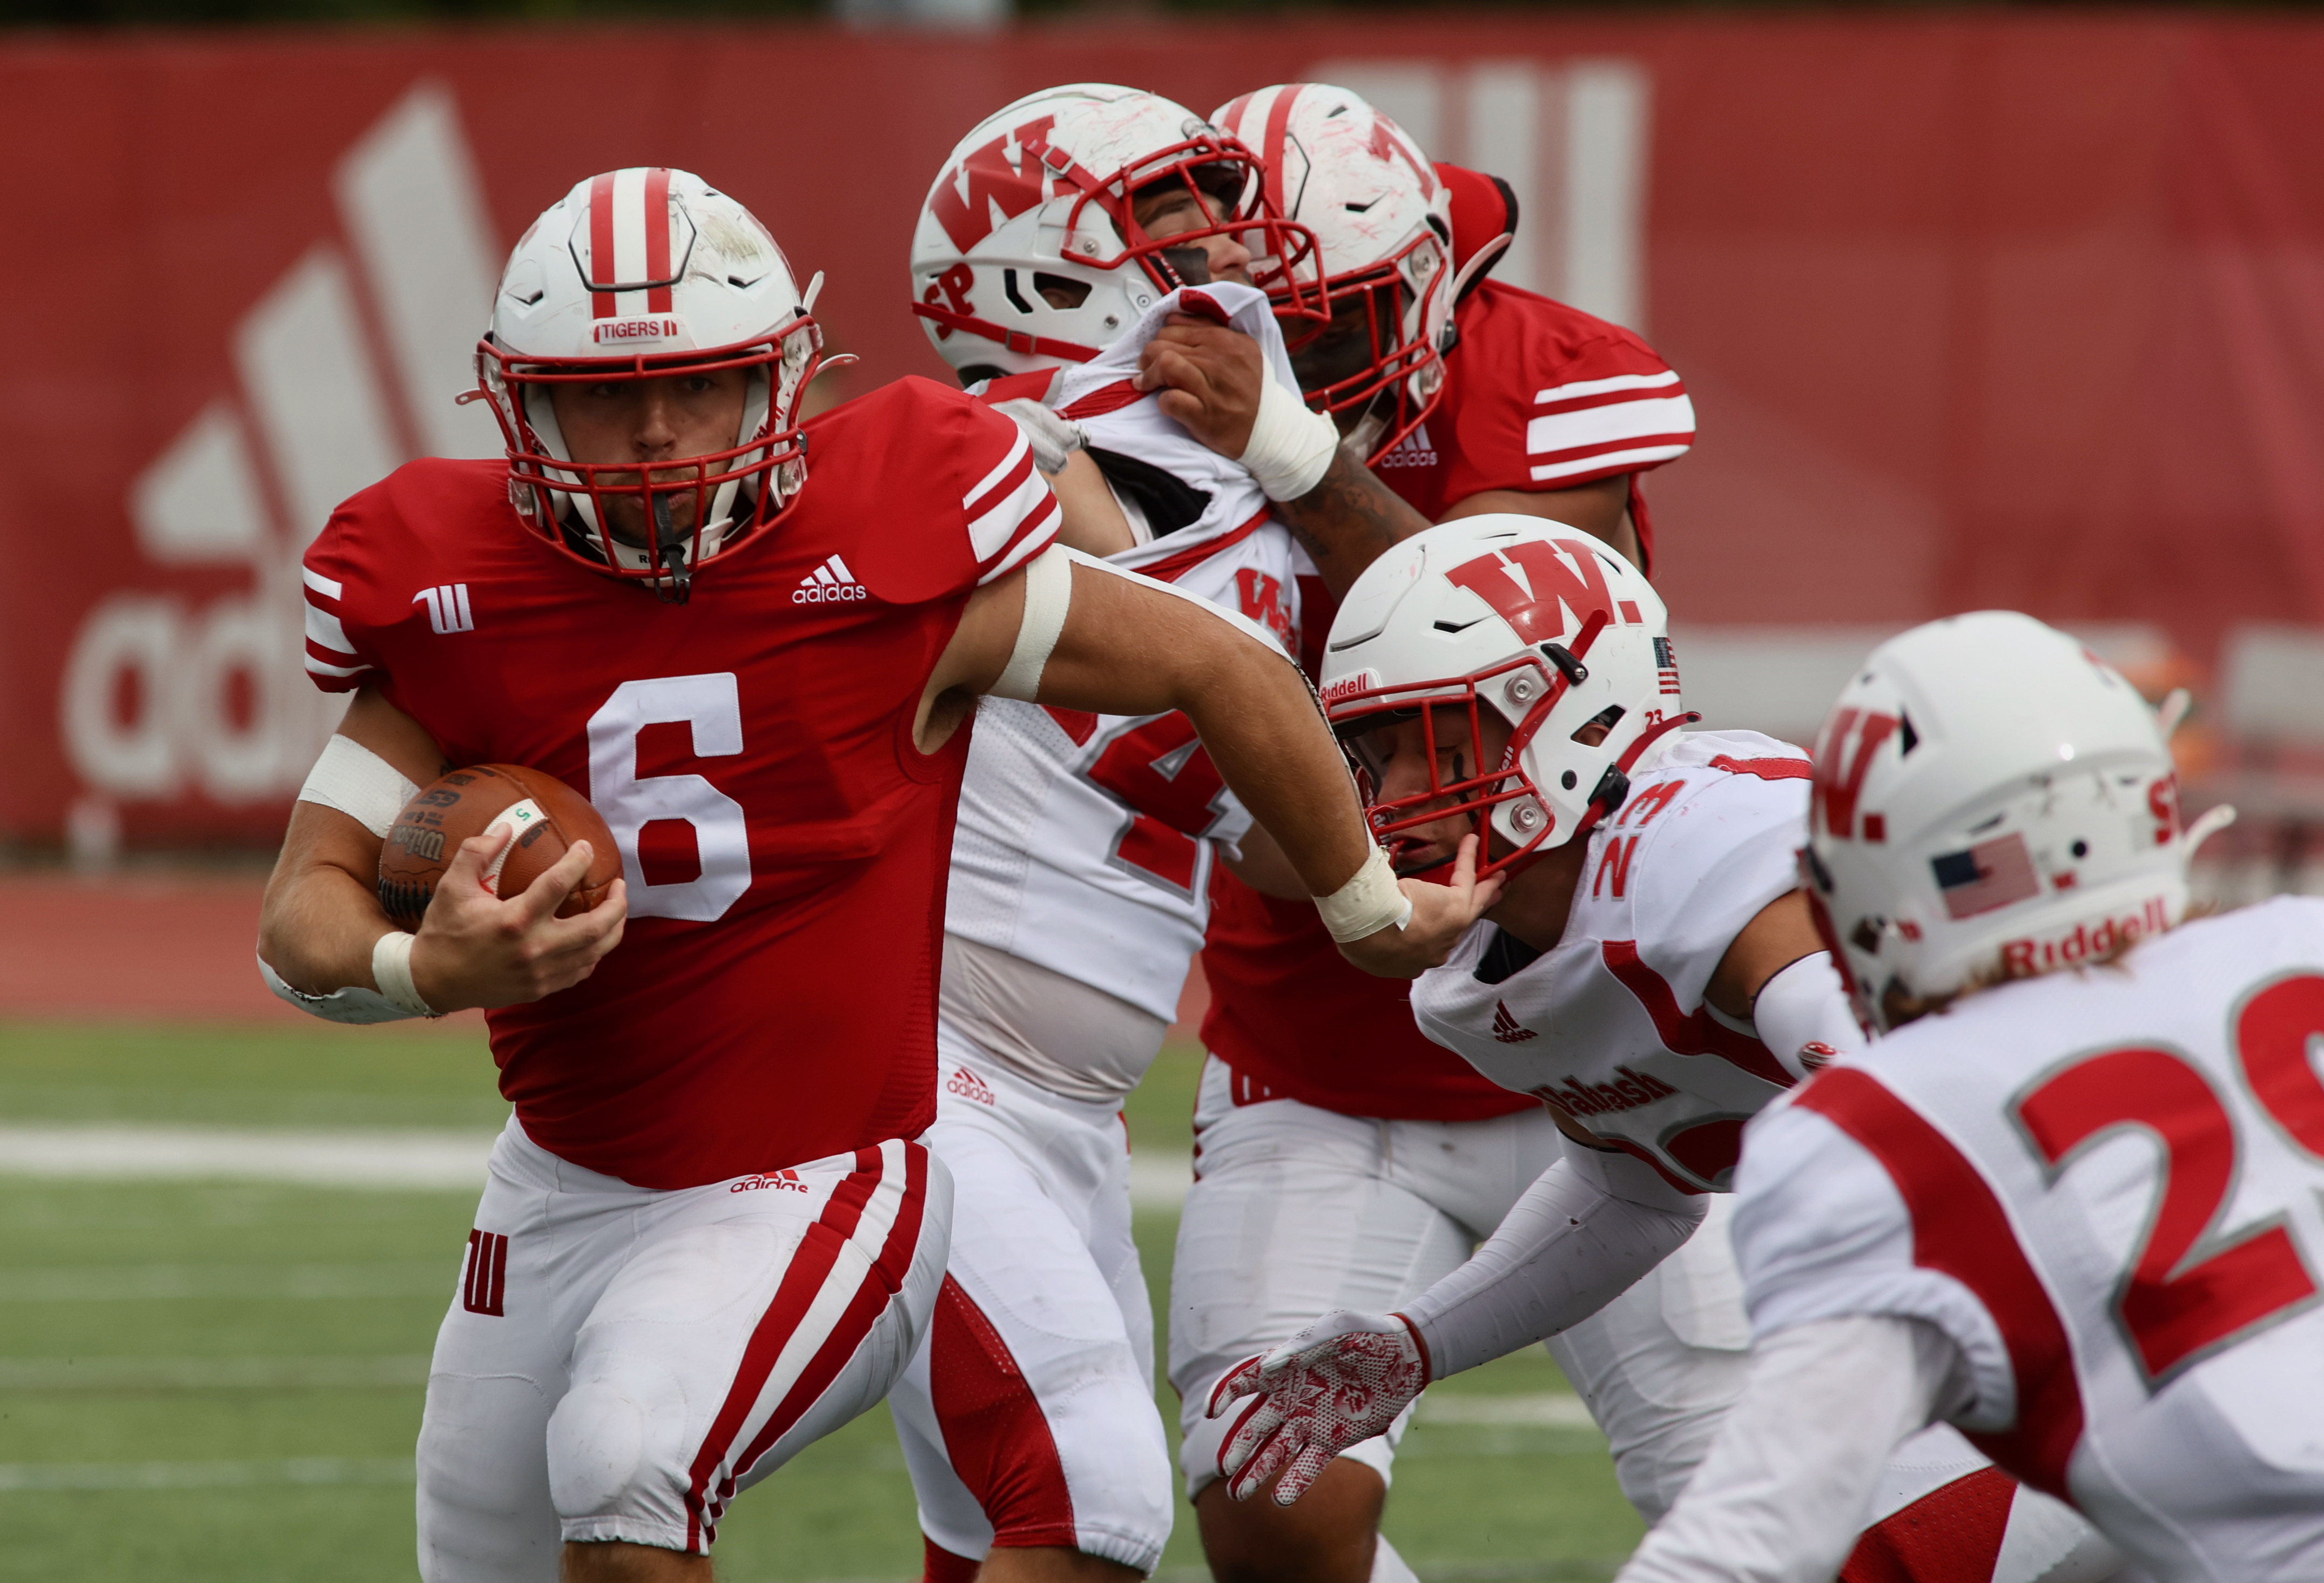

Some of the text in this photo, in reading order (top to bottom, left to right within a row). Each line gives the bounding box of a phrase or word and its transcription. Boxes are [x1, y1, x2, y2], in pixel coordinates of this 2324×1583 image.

[602, 321, 659, 338] TIGERS
[1380, 451, 1438, 468] adidas
[792, 582, 867, 604] adidas
[1321, 672, 1367, 701] Riddell
[1645, 709, 1663, 732] 23
[587, 672, 752, 922] 6
[1592, 778, 1689, 901] 23
[2002, 895, 2167, 975] Riddell
[947, 1080, 994, 1106] adidas
[730, 1177, 809, 1194] adidas
